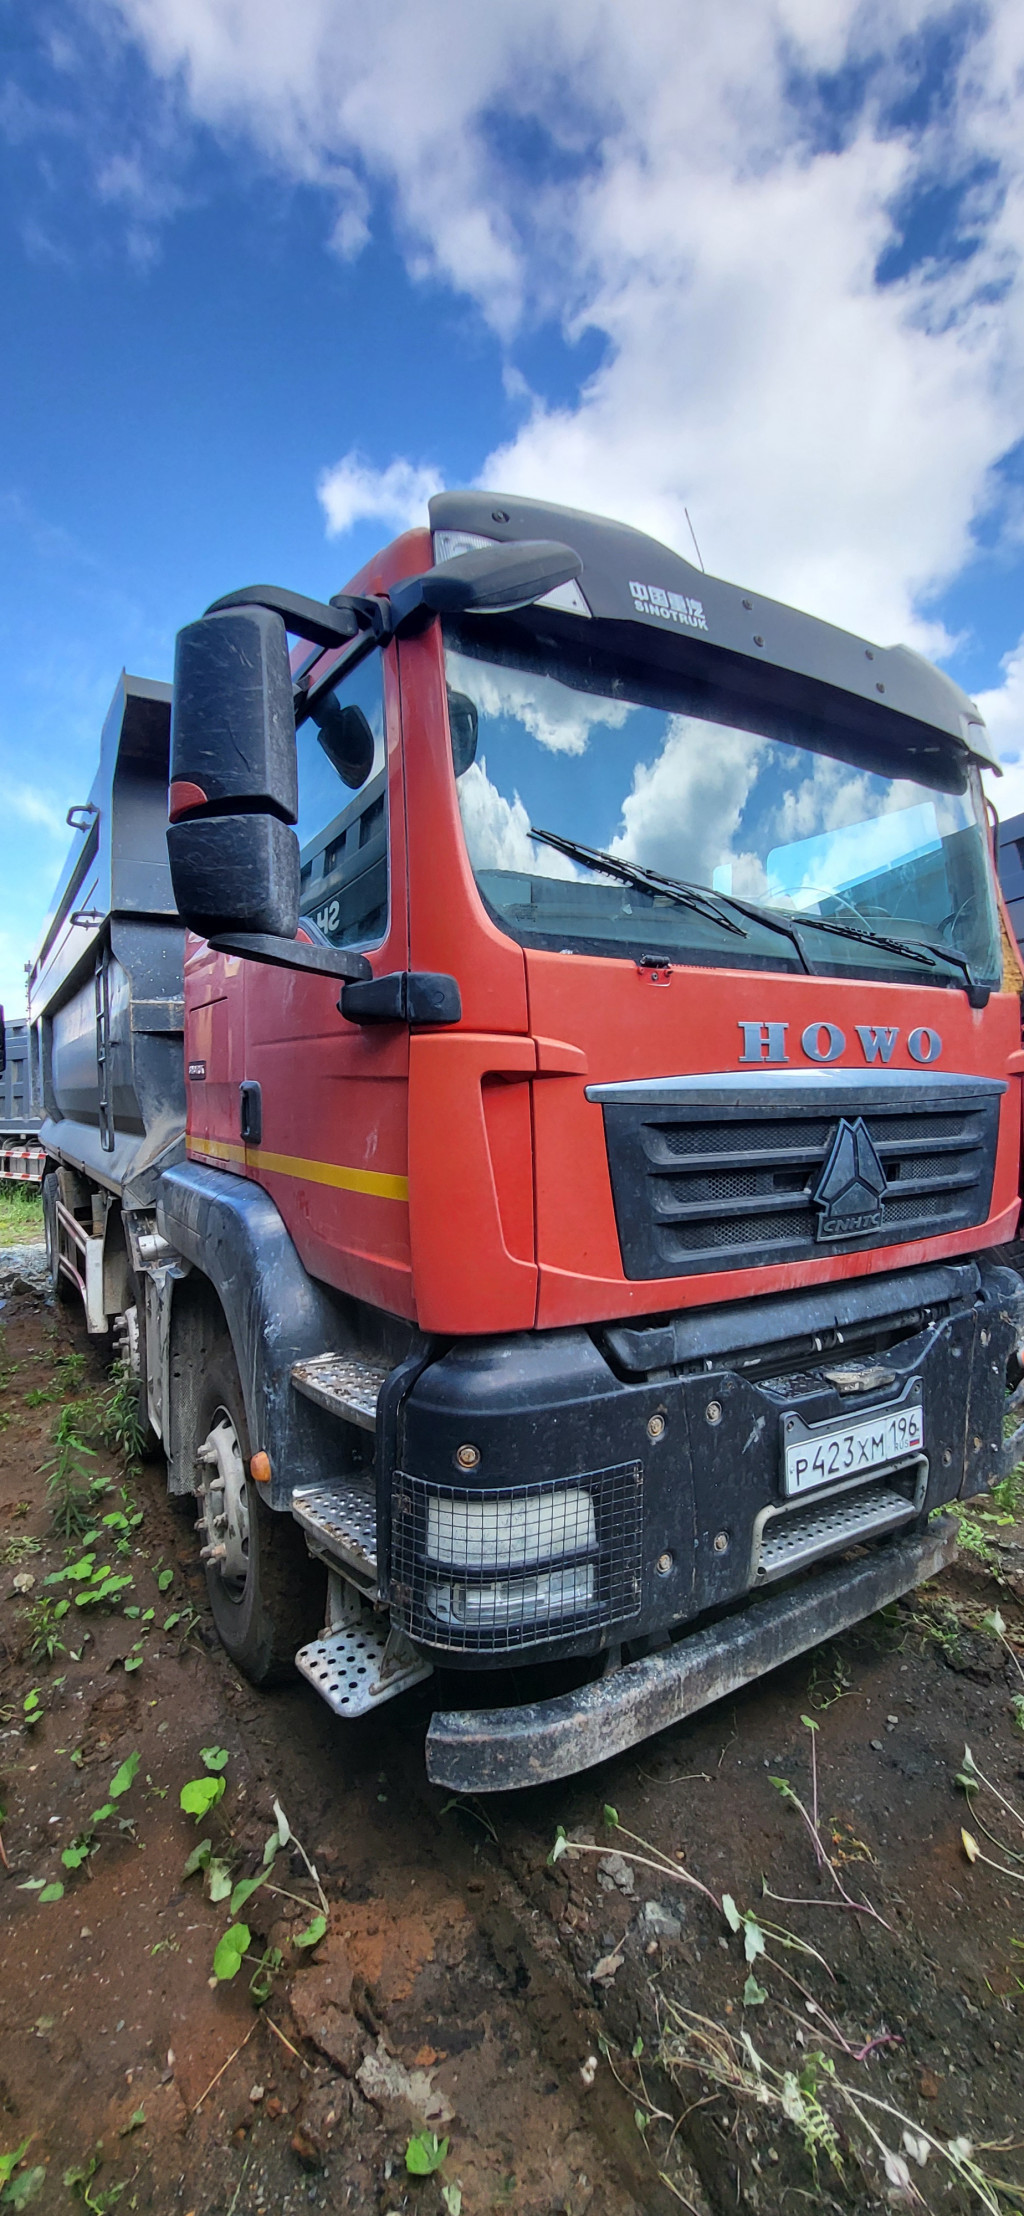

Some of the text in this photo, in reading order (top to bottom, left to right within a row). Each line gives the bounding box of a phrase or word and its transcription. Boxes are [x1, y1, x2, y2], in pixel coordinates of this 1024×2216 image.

[634, 600, 708, 631] SINOTRUK
[738, 1021, 942, 1063] HOWO
[823, 1212, 880, 1232] CNHTC
[889, 1414, 917, 1443] 196
[895, 1440, 909, 1452] RUS
